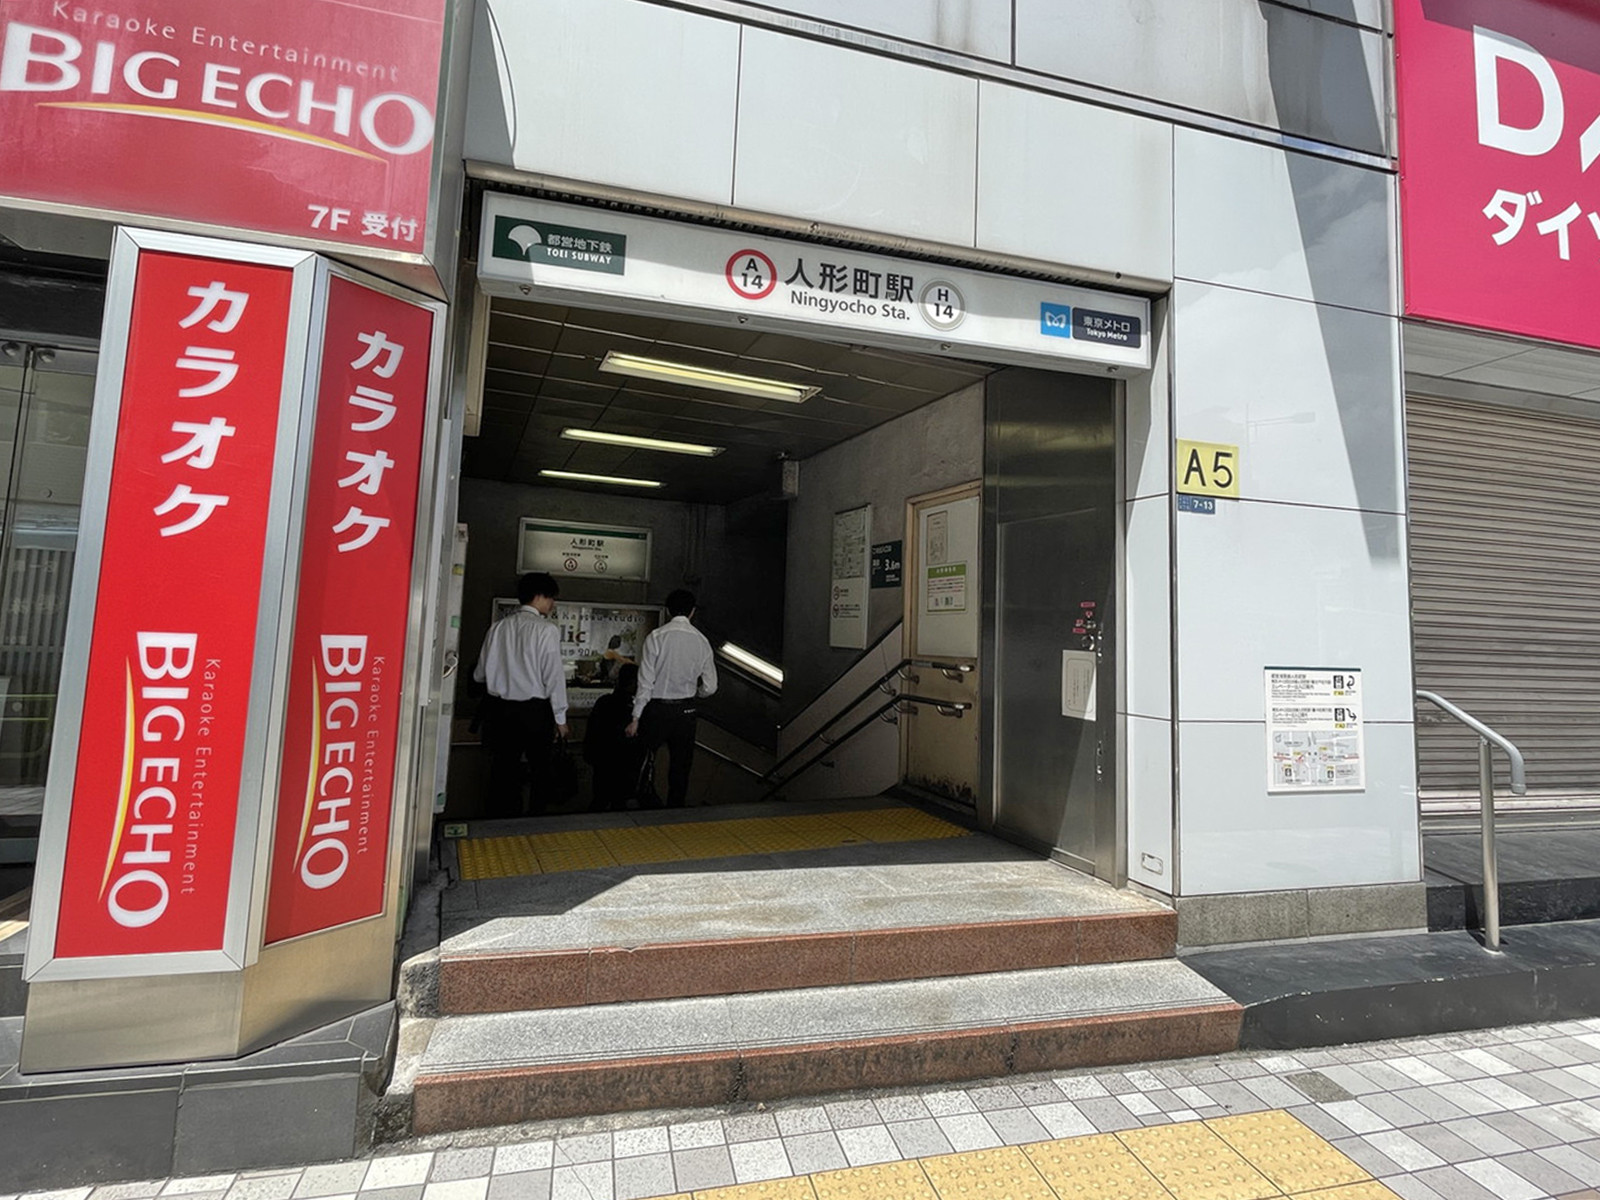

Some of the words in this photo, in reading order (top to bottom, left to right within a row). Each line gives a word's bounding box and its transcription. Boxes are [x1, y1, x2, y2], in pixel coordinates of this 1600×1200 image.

[52, 1, 176, 39] Karaoke
[192, 27, 400, 82] Entertainment
[0, 21, 180, 100] BIG
[201, 62, 434, 155] ECHO
[1473, 25, 1600, 173] D
[308, 204, 351, 231] 7F
[361, 211, 418, 242] 受付
[547, 234, 612, 254] 都営地下鉄
[546, 248, 568, 258] TOEI
[572, 252, 612, 265] SUBWAY
[741, 273, 764, 289] 14
[745, 258, 759, 273] A
[785, 258, 915, 304] 人形町駅
[791, 289, 876, 315] Ningyocho
[882, 302, 911, 321] Sta.
[933, 304, 954, 319] 14
[937, 289, 949, 302] H
[1083, 316, 1130, 332] 東京メトロ
[1086, 328, 1106, 339] Tokyo
[1107, 331, 1128, 341] Metro
[153, 281, 249, 537] カラオケ
[332, 331, 404, 553] カラオケ
[1183, 448, 1233, 488] A5
[1193, 499, 1213, 511] 7-13
[136, 631, 198, 742] BIG
[199, 658, 221, 737] Karaoke
[320, 634, 368, 731] BIG
[366, 656, 385, 723] Karaoke
[300, 741, 357, 890] ECHO
[356, 729, 380, 855] Entertainment
[107, 757, 181, 928] ECHO
[180, 746, 213, 895] Entertainment
